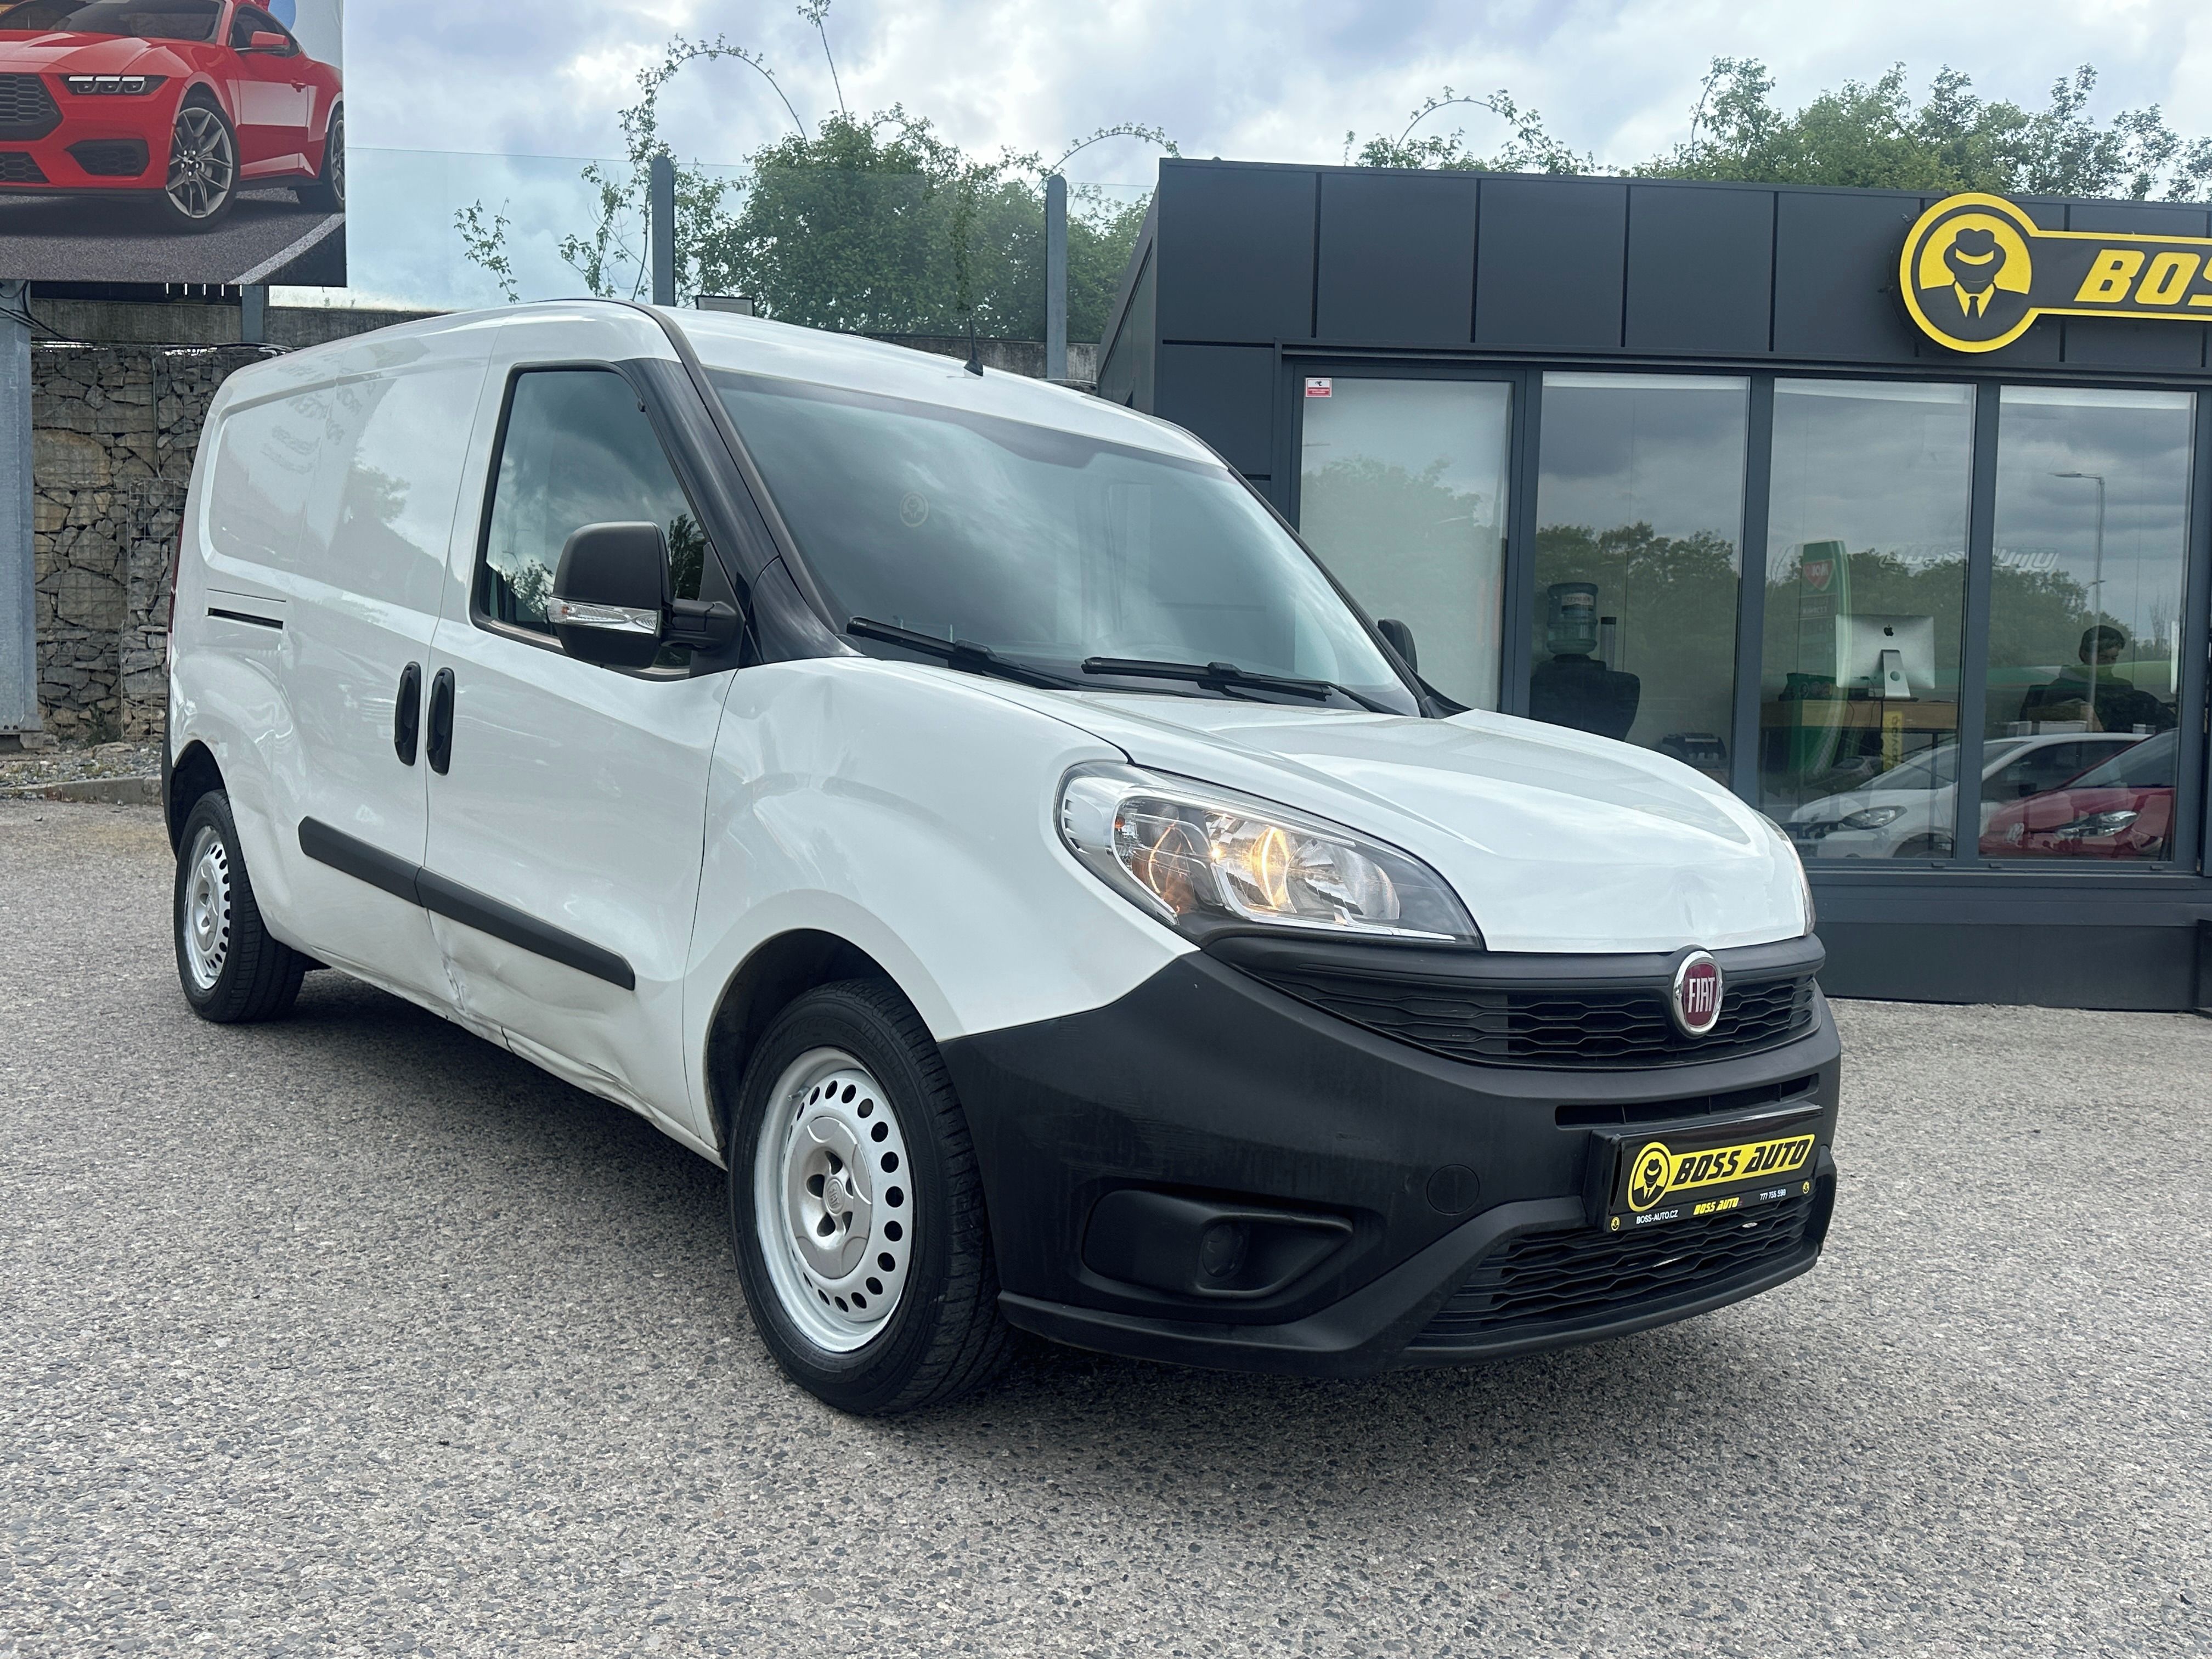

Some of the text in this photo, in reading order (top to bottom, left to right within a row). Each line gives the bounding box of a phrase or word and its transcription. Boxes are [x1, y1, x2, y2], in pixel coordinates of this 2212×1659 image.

[1688, 977, 1716, 1013] FIAT
[1672, 1139, 1810, 1186] BOSS AUTO
[1636, 1209, 1678, 1224] BOSS-AUTO.CZ
[1693, 1197, 1740, 1216] BOSS AUTO
